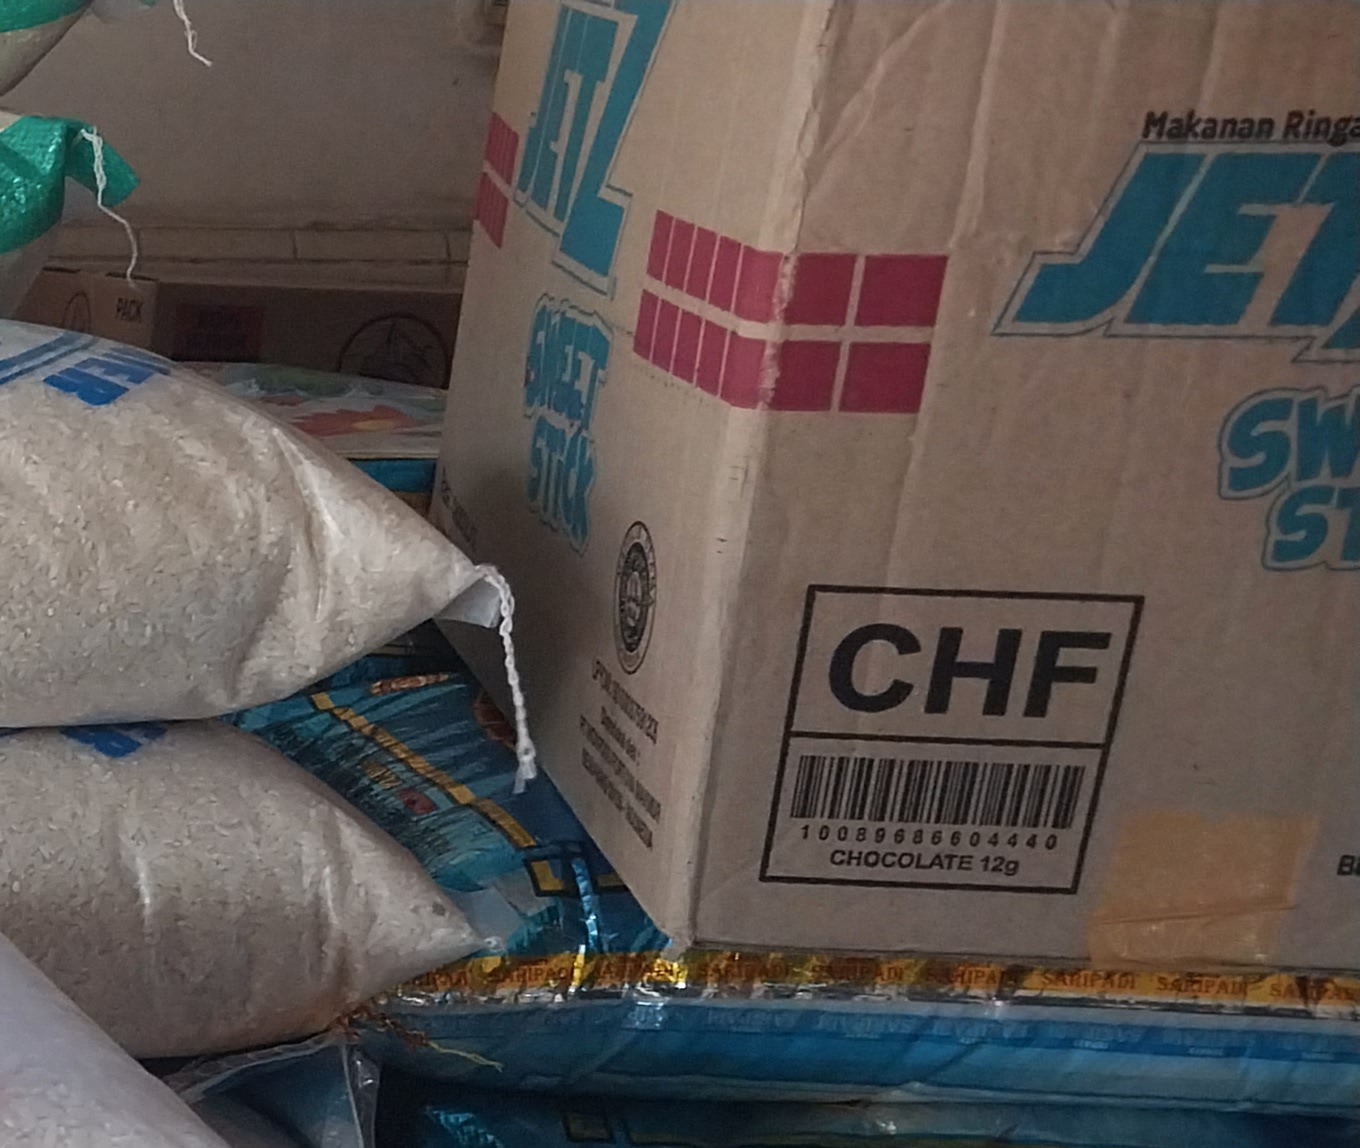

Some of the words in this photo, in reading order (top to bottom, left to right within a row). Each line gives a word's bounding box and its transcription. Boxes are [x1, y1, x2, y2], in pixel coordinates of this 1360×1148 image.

[1142, 108, 1275, 139] Makanan
[1012, 152, 1360, 349] JET
[829, 623, 1113, 718] CHF
[829, 849, 974, 871] CHOCOLATE
[980, 855, 1020, 876] 12g
